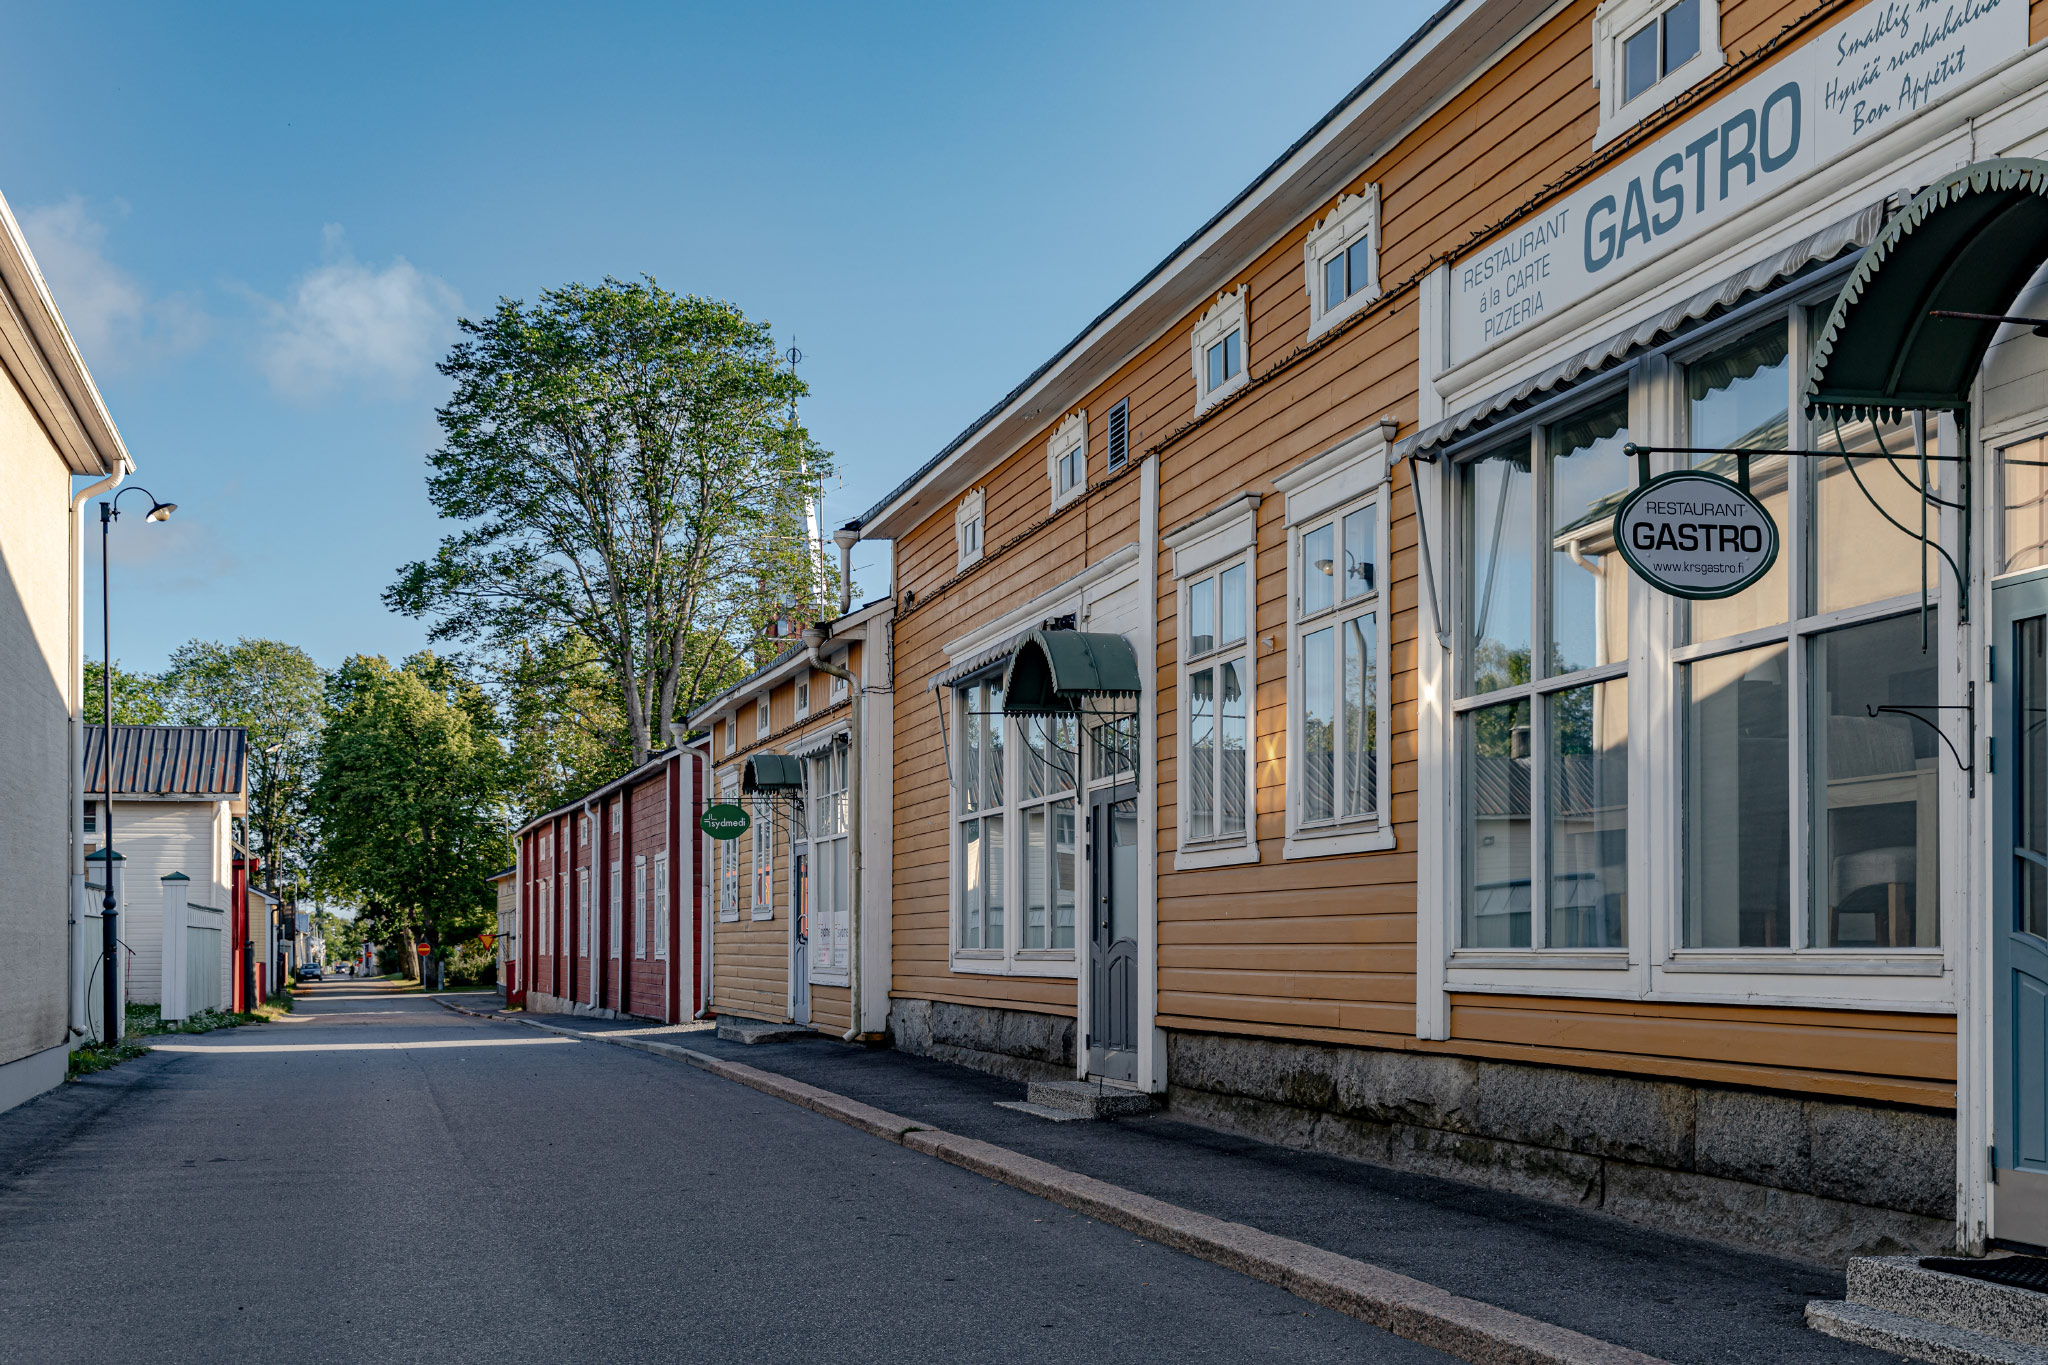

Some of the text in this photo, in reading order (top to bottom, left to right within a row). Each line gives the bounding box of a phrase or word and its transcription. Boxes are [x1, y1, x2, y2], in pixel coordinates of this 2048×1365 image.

[1836, 2, 1910, 67] Smaklig
[1825, 55, 1881, 115] Hyvää
[1852, 45, 1966, 136] Bon Appétit
[1583, 81, 1802, 274] GASTRO
[1463, 208, 1570, 293] RESTAURANT
[1489, 286, 1500, 309] la
[1506, 252, 1551, 298] CARTE
[1484, 290, 1544, 342] PIZZERIA
[1632, 521, 1763, 553] GASTRO
[1646, 501, 1746, 517] RESTAURANT
[1652, 560, 1745, 576] www.krsgastro.fi
[711, 817, 746, 830] sydmedi
